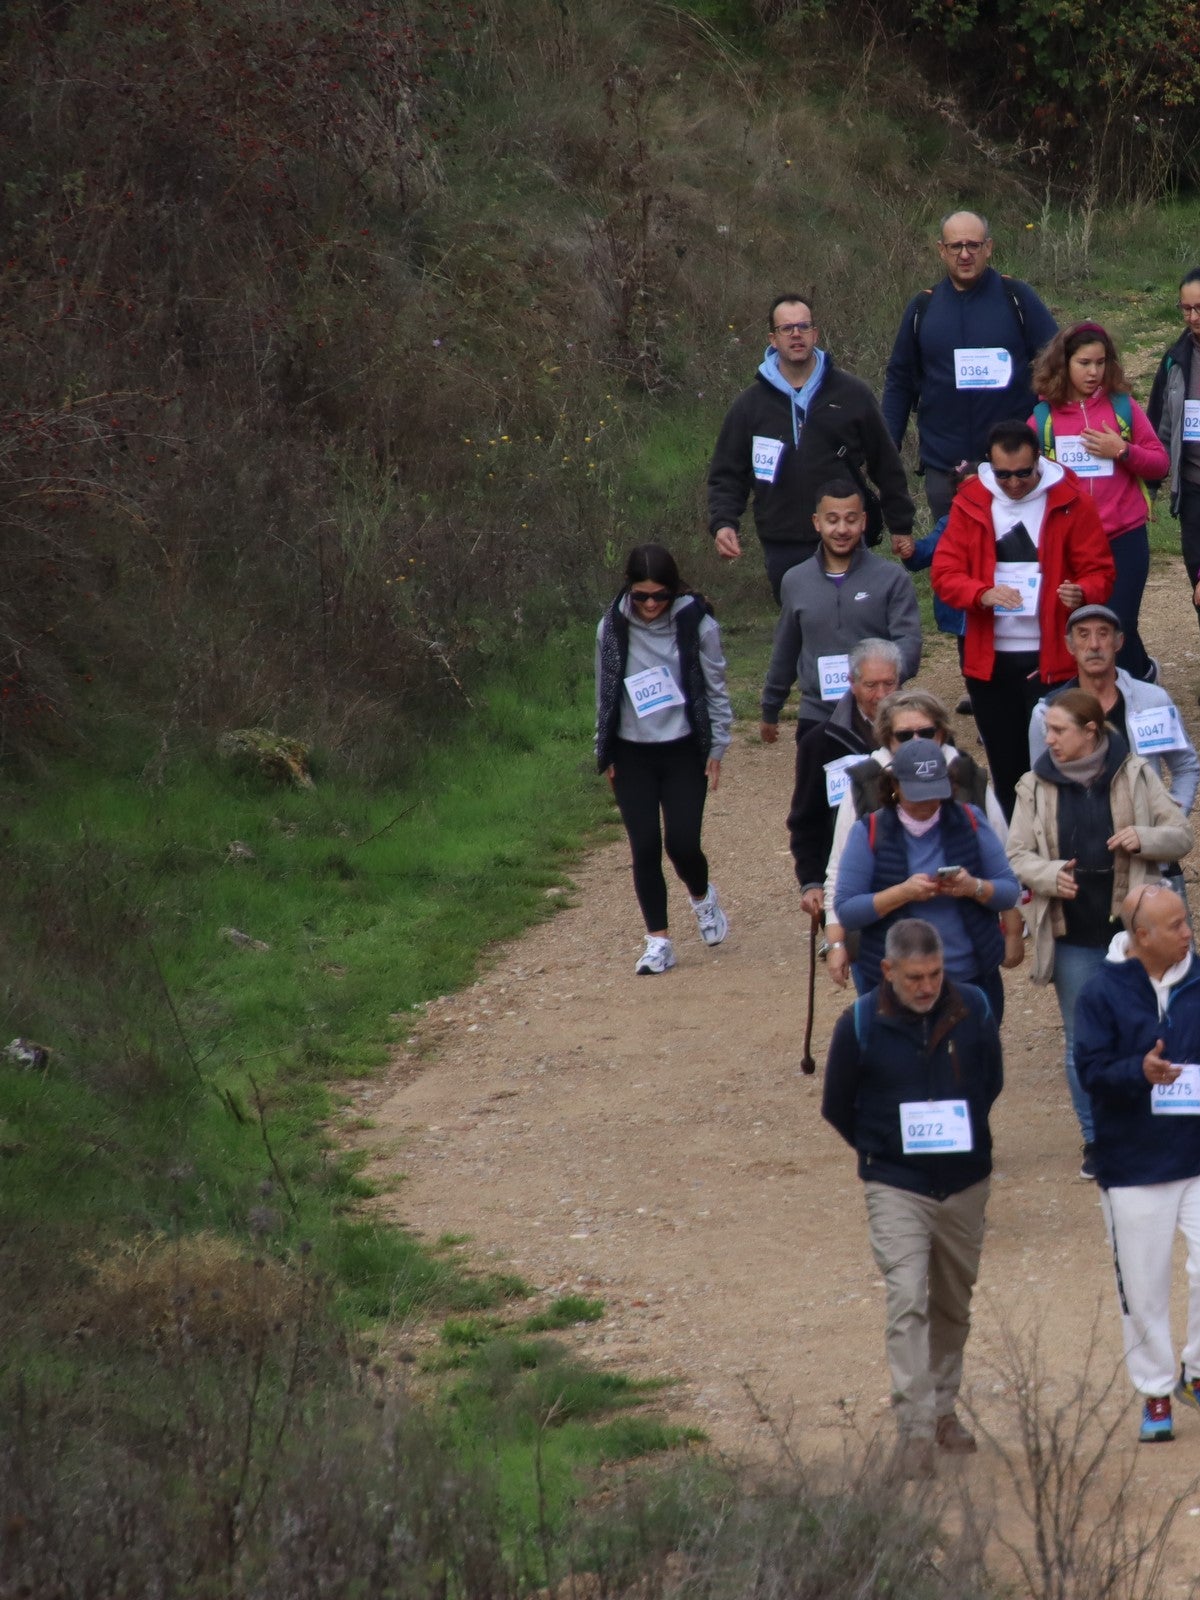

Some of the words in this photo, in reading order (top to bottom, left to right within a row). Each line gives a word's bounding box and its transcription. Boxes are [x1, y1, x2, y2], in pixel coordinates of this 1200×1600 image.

[961, 366, 989, 376] 0364
[755, 454, 776, 465] 034
[1062, 451, 1091, 462] 0393
[825, 672, 849, 684] 036
[635, 682, 662, 701] 0027
[1137, 723, 1164, 737] 0047
[1158, 1083, 1192, 1096] 0275
[908, 1123, 943, 1136] 0272
